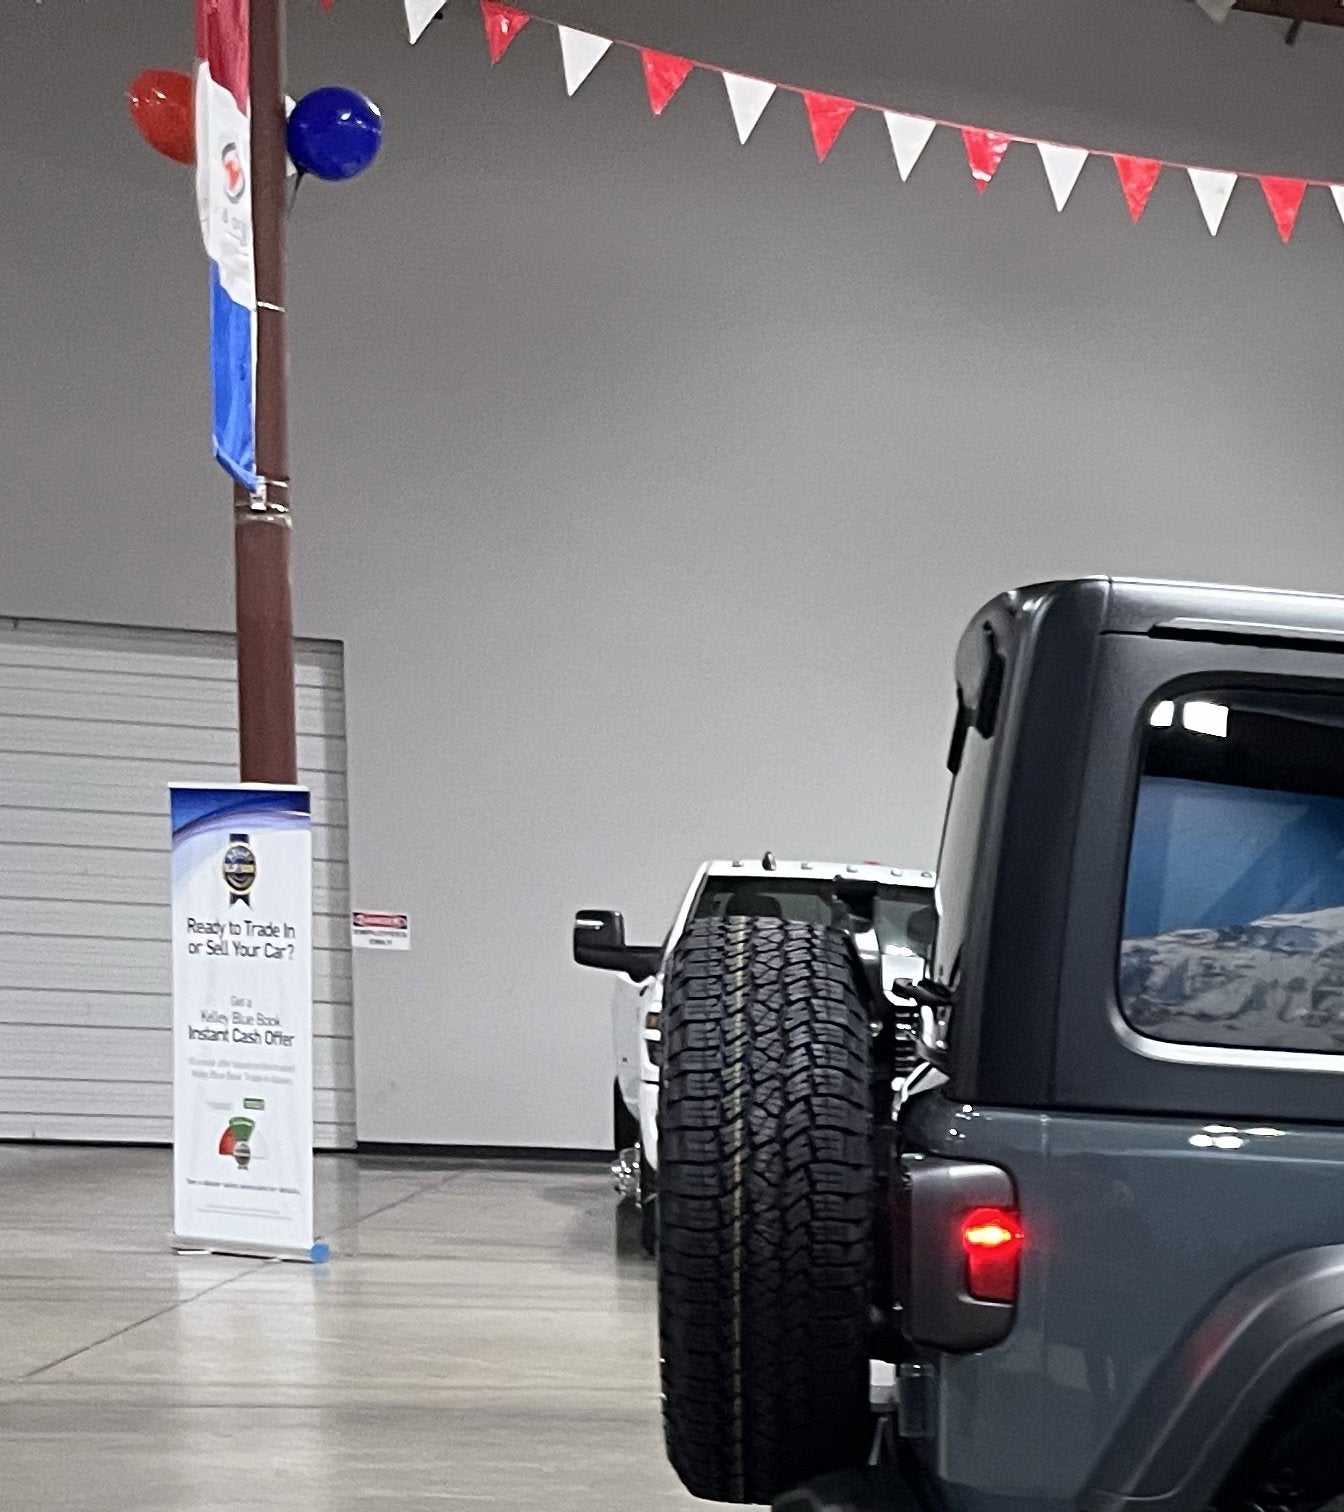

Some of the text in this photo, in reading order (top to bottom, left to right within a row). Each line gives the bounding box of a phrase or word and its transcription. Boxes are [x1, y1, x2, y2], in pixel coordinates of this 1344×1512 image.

[187, 917, 296, 940] Ready to Trade In
[188, 939, 295, 960] or Sell Your Car?
[188, 1024, 295, 1047] Instant Cash Offer
